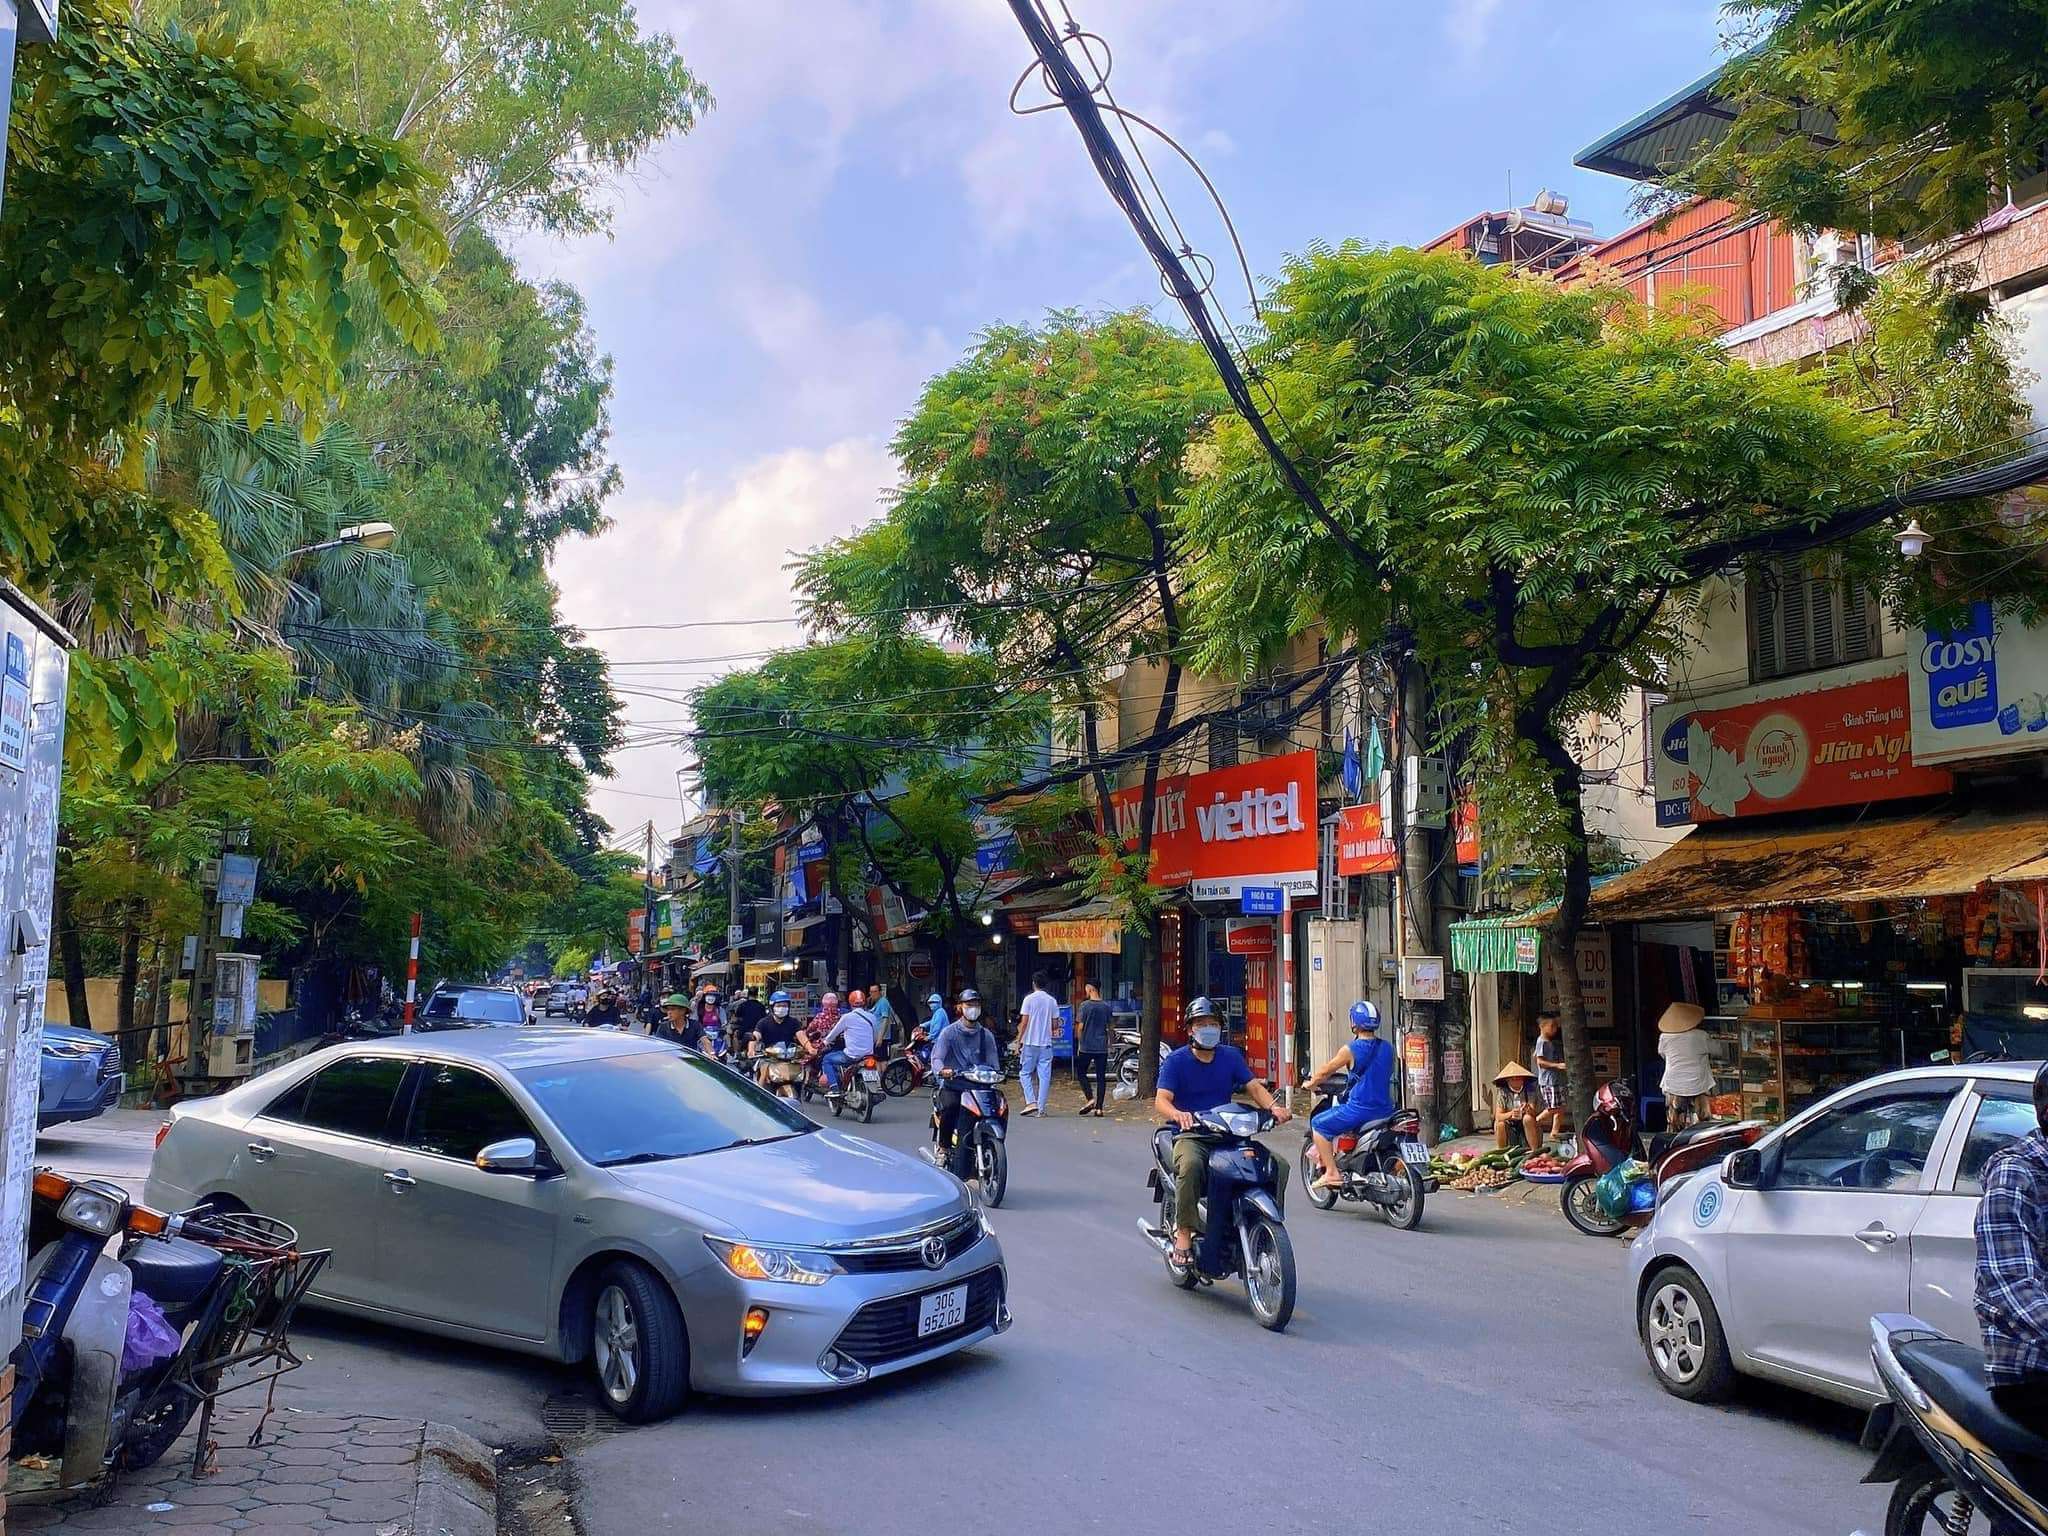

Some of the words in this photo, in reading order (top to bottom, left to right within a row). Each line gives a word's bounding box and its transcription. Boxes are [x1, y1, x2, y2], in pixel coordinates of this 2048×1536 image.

[1921, 633, 2000, 673] COSY
[1937, 667, 1988, 708] QUẾ
[1762, 742, 1788, 755] thanh
[1672, 777, 1686, 791] ISO
[1196, 781, 1305, 843] viettel
[934, 1292, 955, 1312] 30G
[924, 1308, 961, 1333] 952.02
